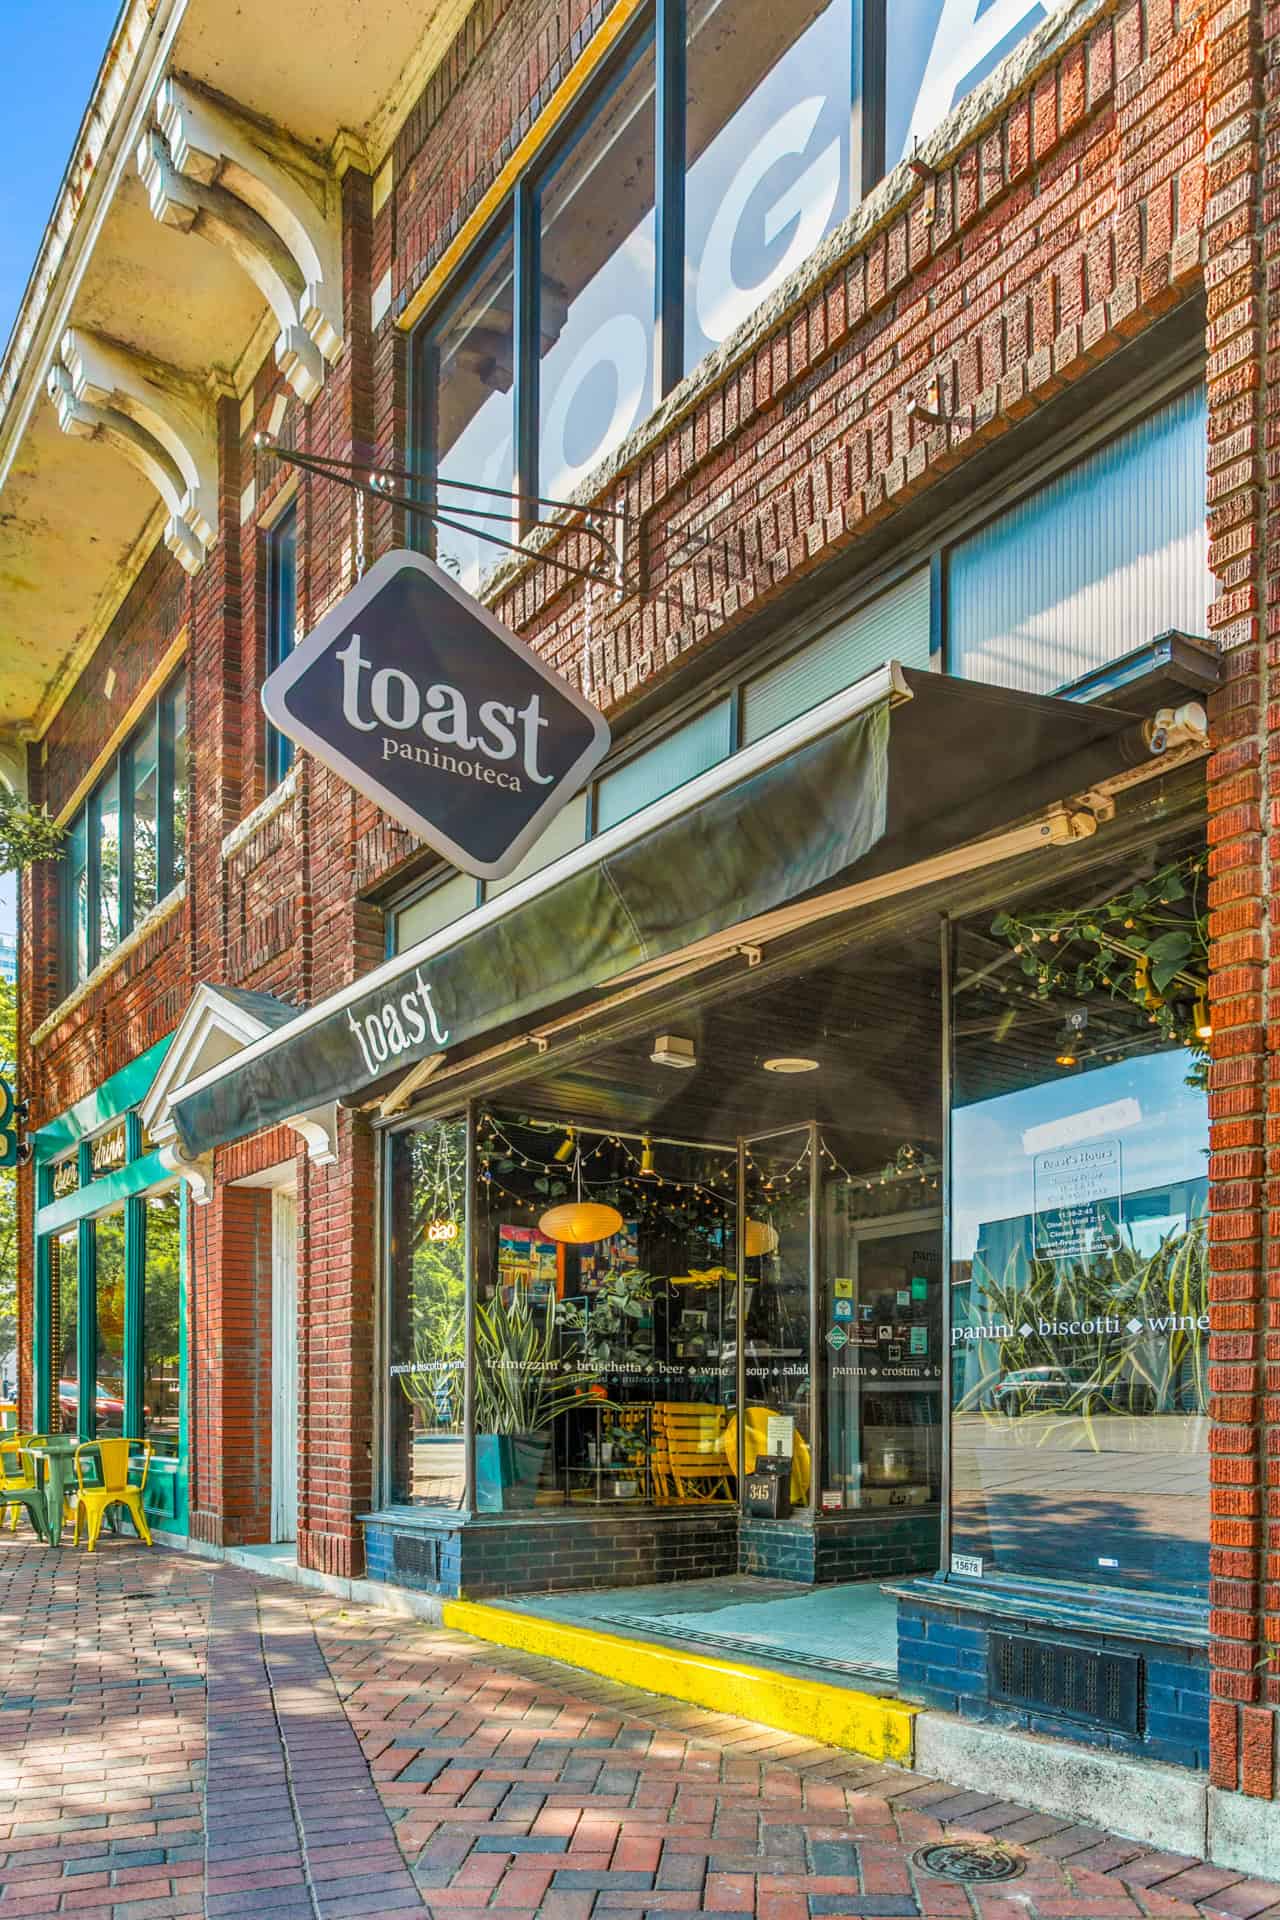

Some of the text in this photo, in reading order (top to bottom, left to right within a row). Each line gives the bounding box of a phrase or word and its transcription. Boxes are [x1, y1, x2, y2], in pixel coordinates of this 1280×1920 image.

[336, 634, 554, 785] toast
[382, 737, 523, 793] paninoteca
[346, 967, 449, 1076] toast
[428, 1218, 458, 1241] ciao
[951, 1320, 1015, 1346] panini
[1038, 1314, 1122, 1337] biscotti
[1149, 1310, 1210, 1332] wine
[487, 1357, 729, 1376] tramezzini bruschetta beer wine
[745, 1363, 809, 1379] soup salad
[832, 1365, 867, 1379] panini
[881, 1366, 920, 1377] crostini
